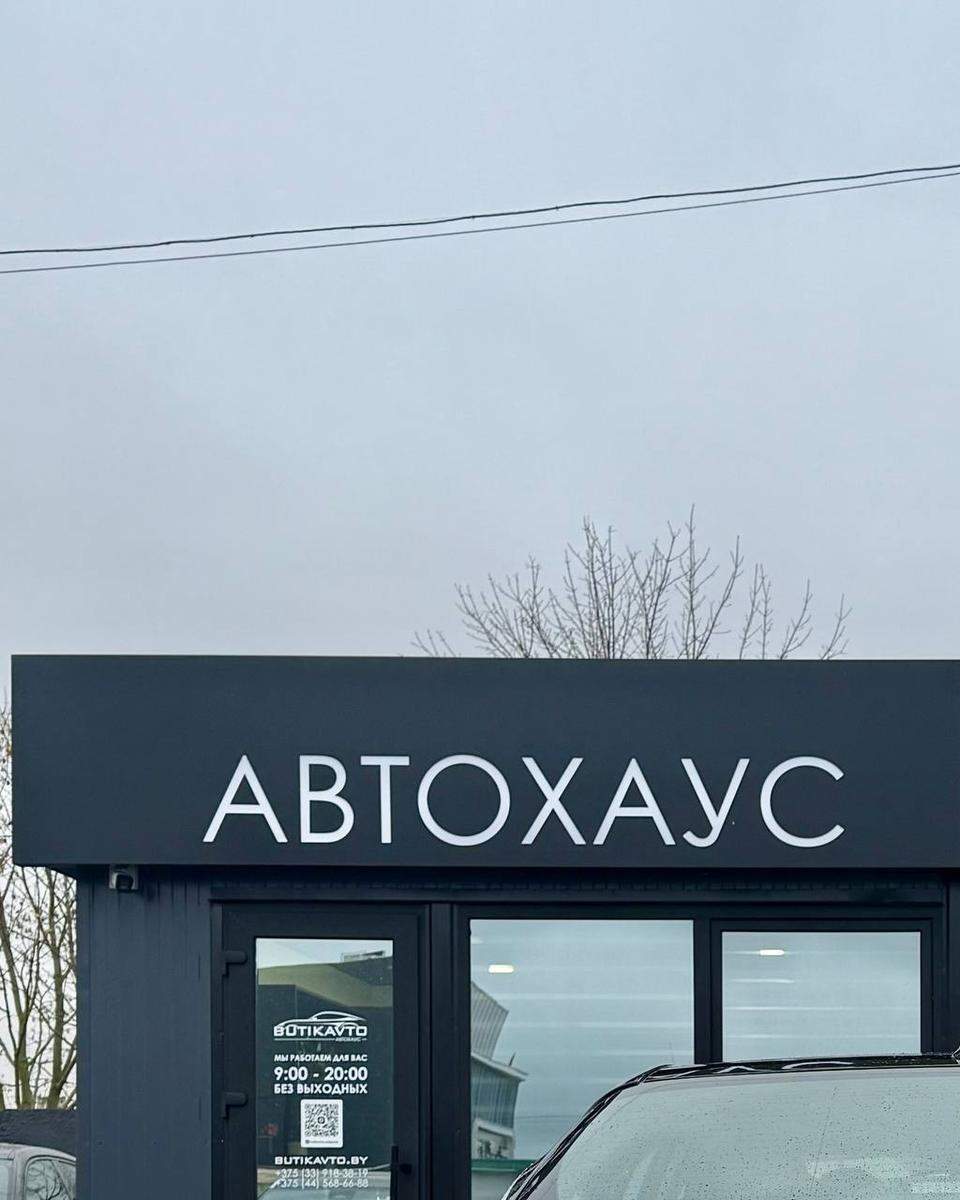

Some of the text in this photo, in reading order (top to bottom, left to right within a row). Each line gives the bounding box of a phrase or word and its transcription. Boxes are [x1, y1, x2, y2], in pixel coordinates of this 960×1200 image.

[203, 754, 845, 848] АВТОХАУС
[273, 1025, 367, 1037] BUTIKAVTO
[274, 1054, 368, 1062] МЫ РАБОТАЕМ ДЛЯ ВАС
[274, 1066, 308, 1081] 9:00
[324, 1066, 368, 1081] 20:00
[274, 1084, 368, 1095] БЕЗ ВЫХОДНЫХ
[275, 1156, 368, 1165] BUTIKAVTO.BY
[276, 1168, 299, 1178] +375
[301, 1168, 320, 1180] (33)
[276, 1179, 299, 1188] +375
[301, 1179, 320, 1189] (44)
